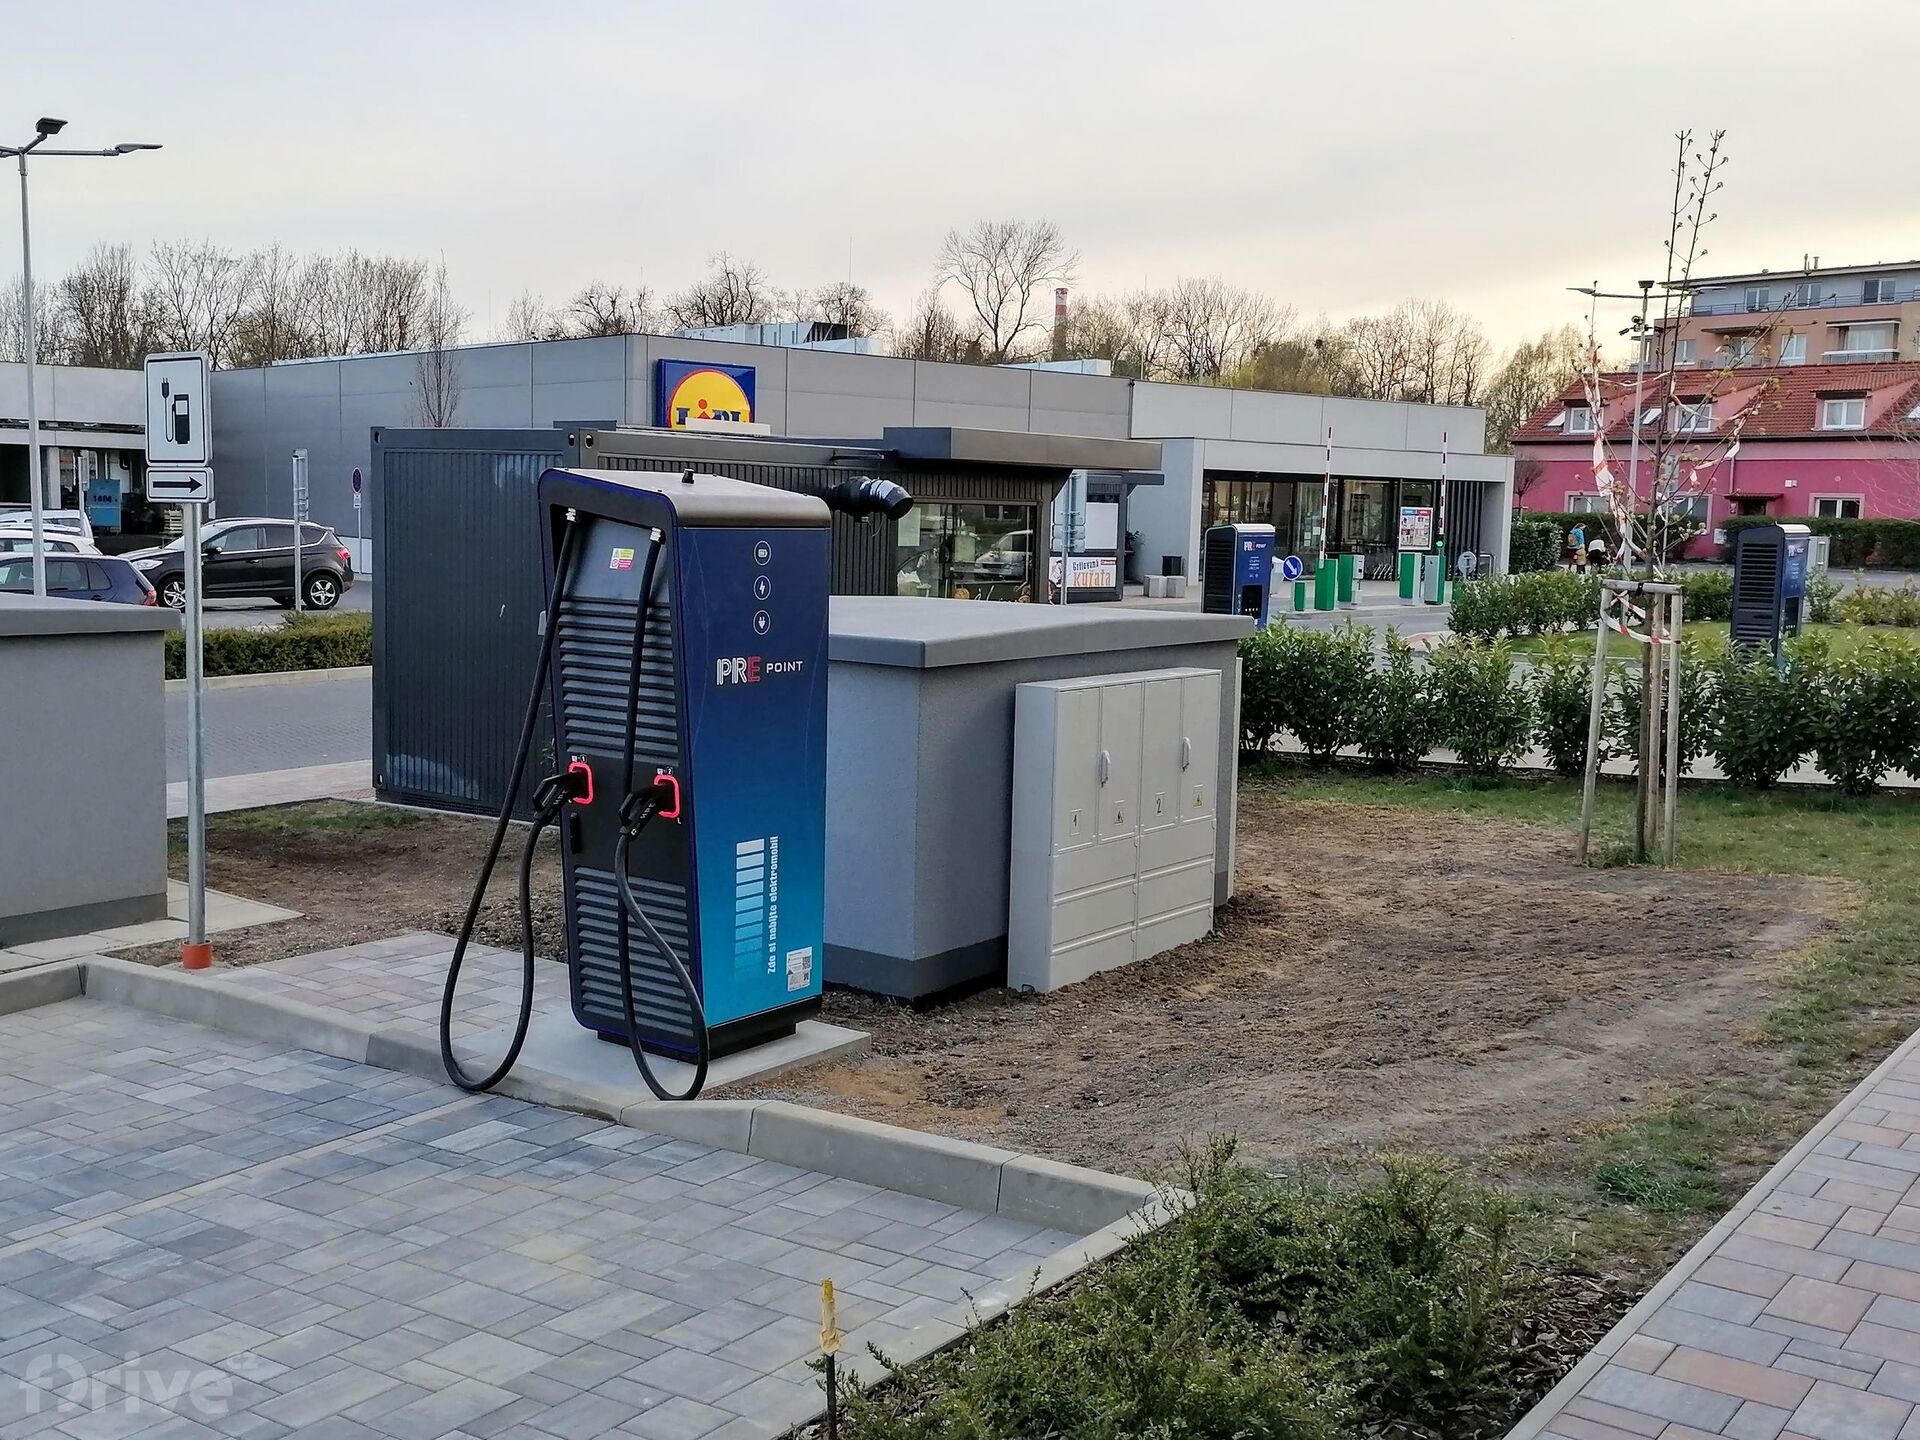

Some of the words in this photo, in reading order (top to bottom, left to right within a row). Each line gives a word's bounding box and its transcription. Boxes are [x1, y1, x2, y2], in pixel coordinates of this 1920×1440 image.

[716, 656, 761, 685] PRE
[766, 661, 803, 673] POINT
[1156, 798, 1162, 814] 2
[1073, 814, 1078, 827] 1
[769, 836, 779, 902] elektromobil
[769, 904, 778, 941] nabijte
[769, 943, 777, 953] si
[768, 955, 776, 974] Zde
